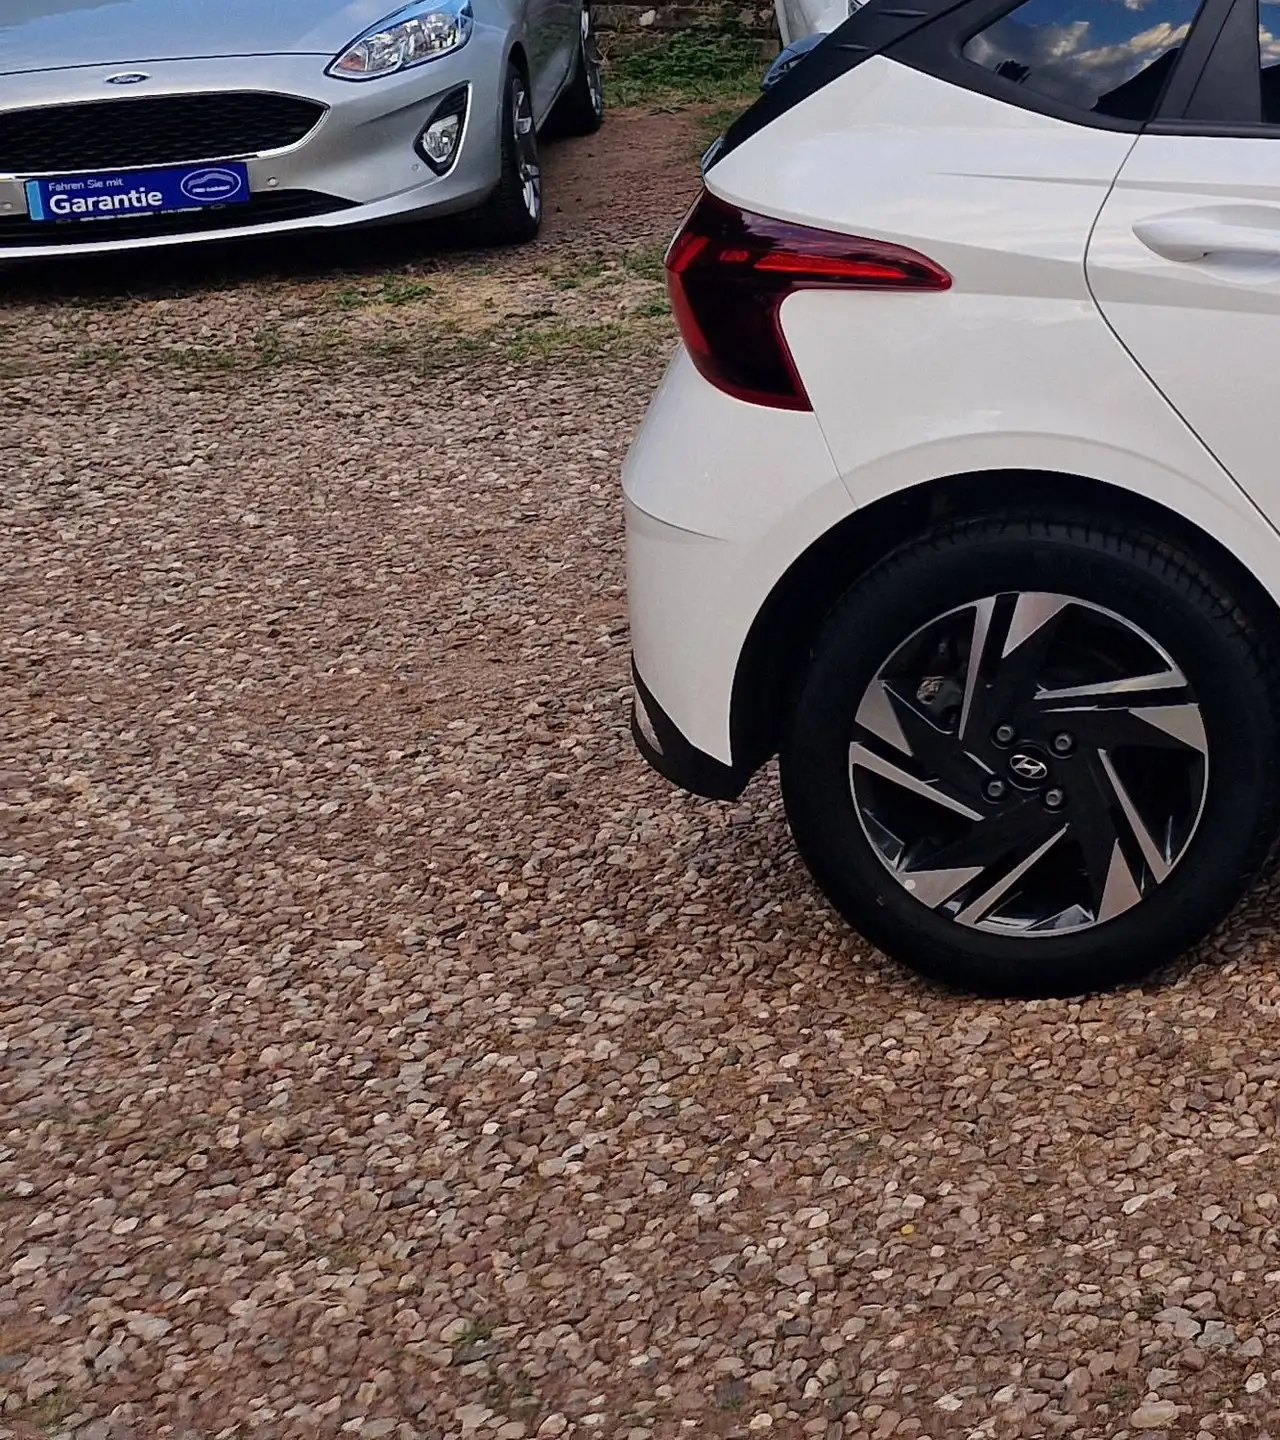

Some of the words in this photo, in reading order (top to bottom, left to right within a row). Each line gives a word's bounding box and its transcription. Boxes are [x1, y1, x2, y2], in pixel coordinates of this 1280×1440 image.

[49, 180, 84, 192] Fahren
[87, 178, 104, 189] Sie
[106, 177, 124, 188] mit
[49, 186, 163, 214] Garantie
